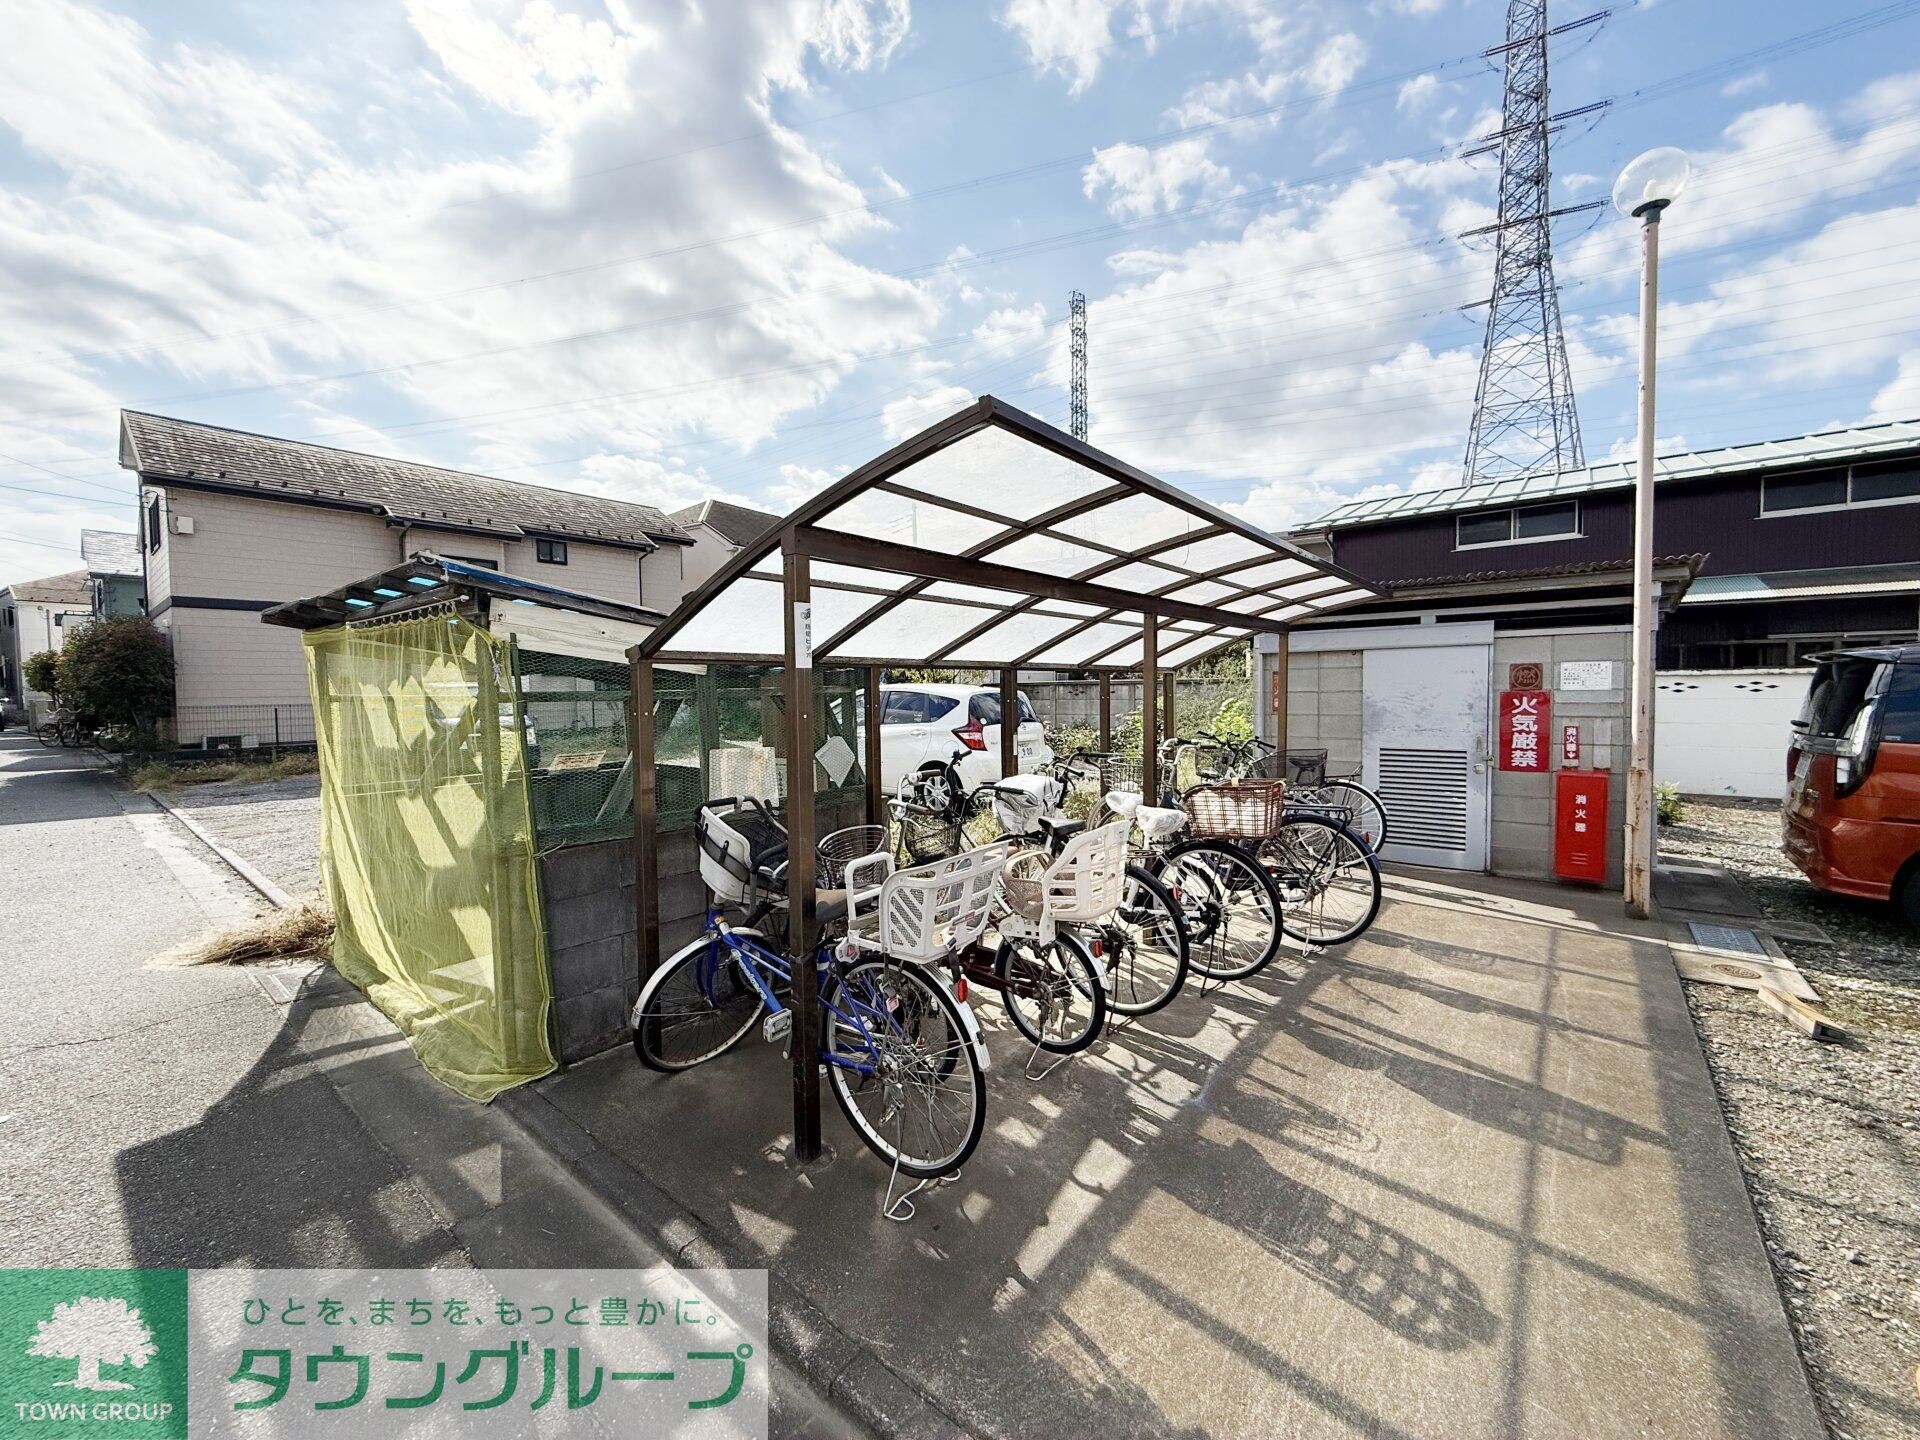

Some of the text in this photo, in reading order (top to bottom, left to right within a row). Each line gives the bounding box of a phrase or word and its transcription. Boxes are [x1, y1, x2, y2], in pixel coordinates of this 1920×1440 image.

[1511, 696, 1538, 767] 火気厳禁
[1566, 727, 1577, 752] 消火器
[1575, 794, 1587, 832] 消火器
